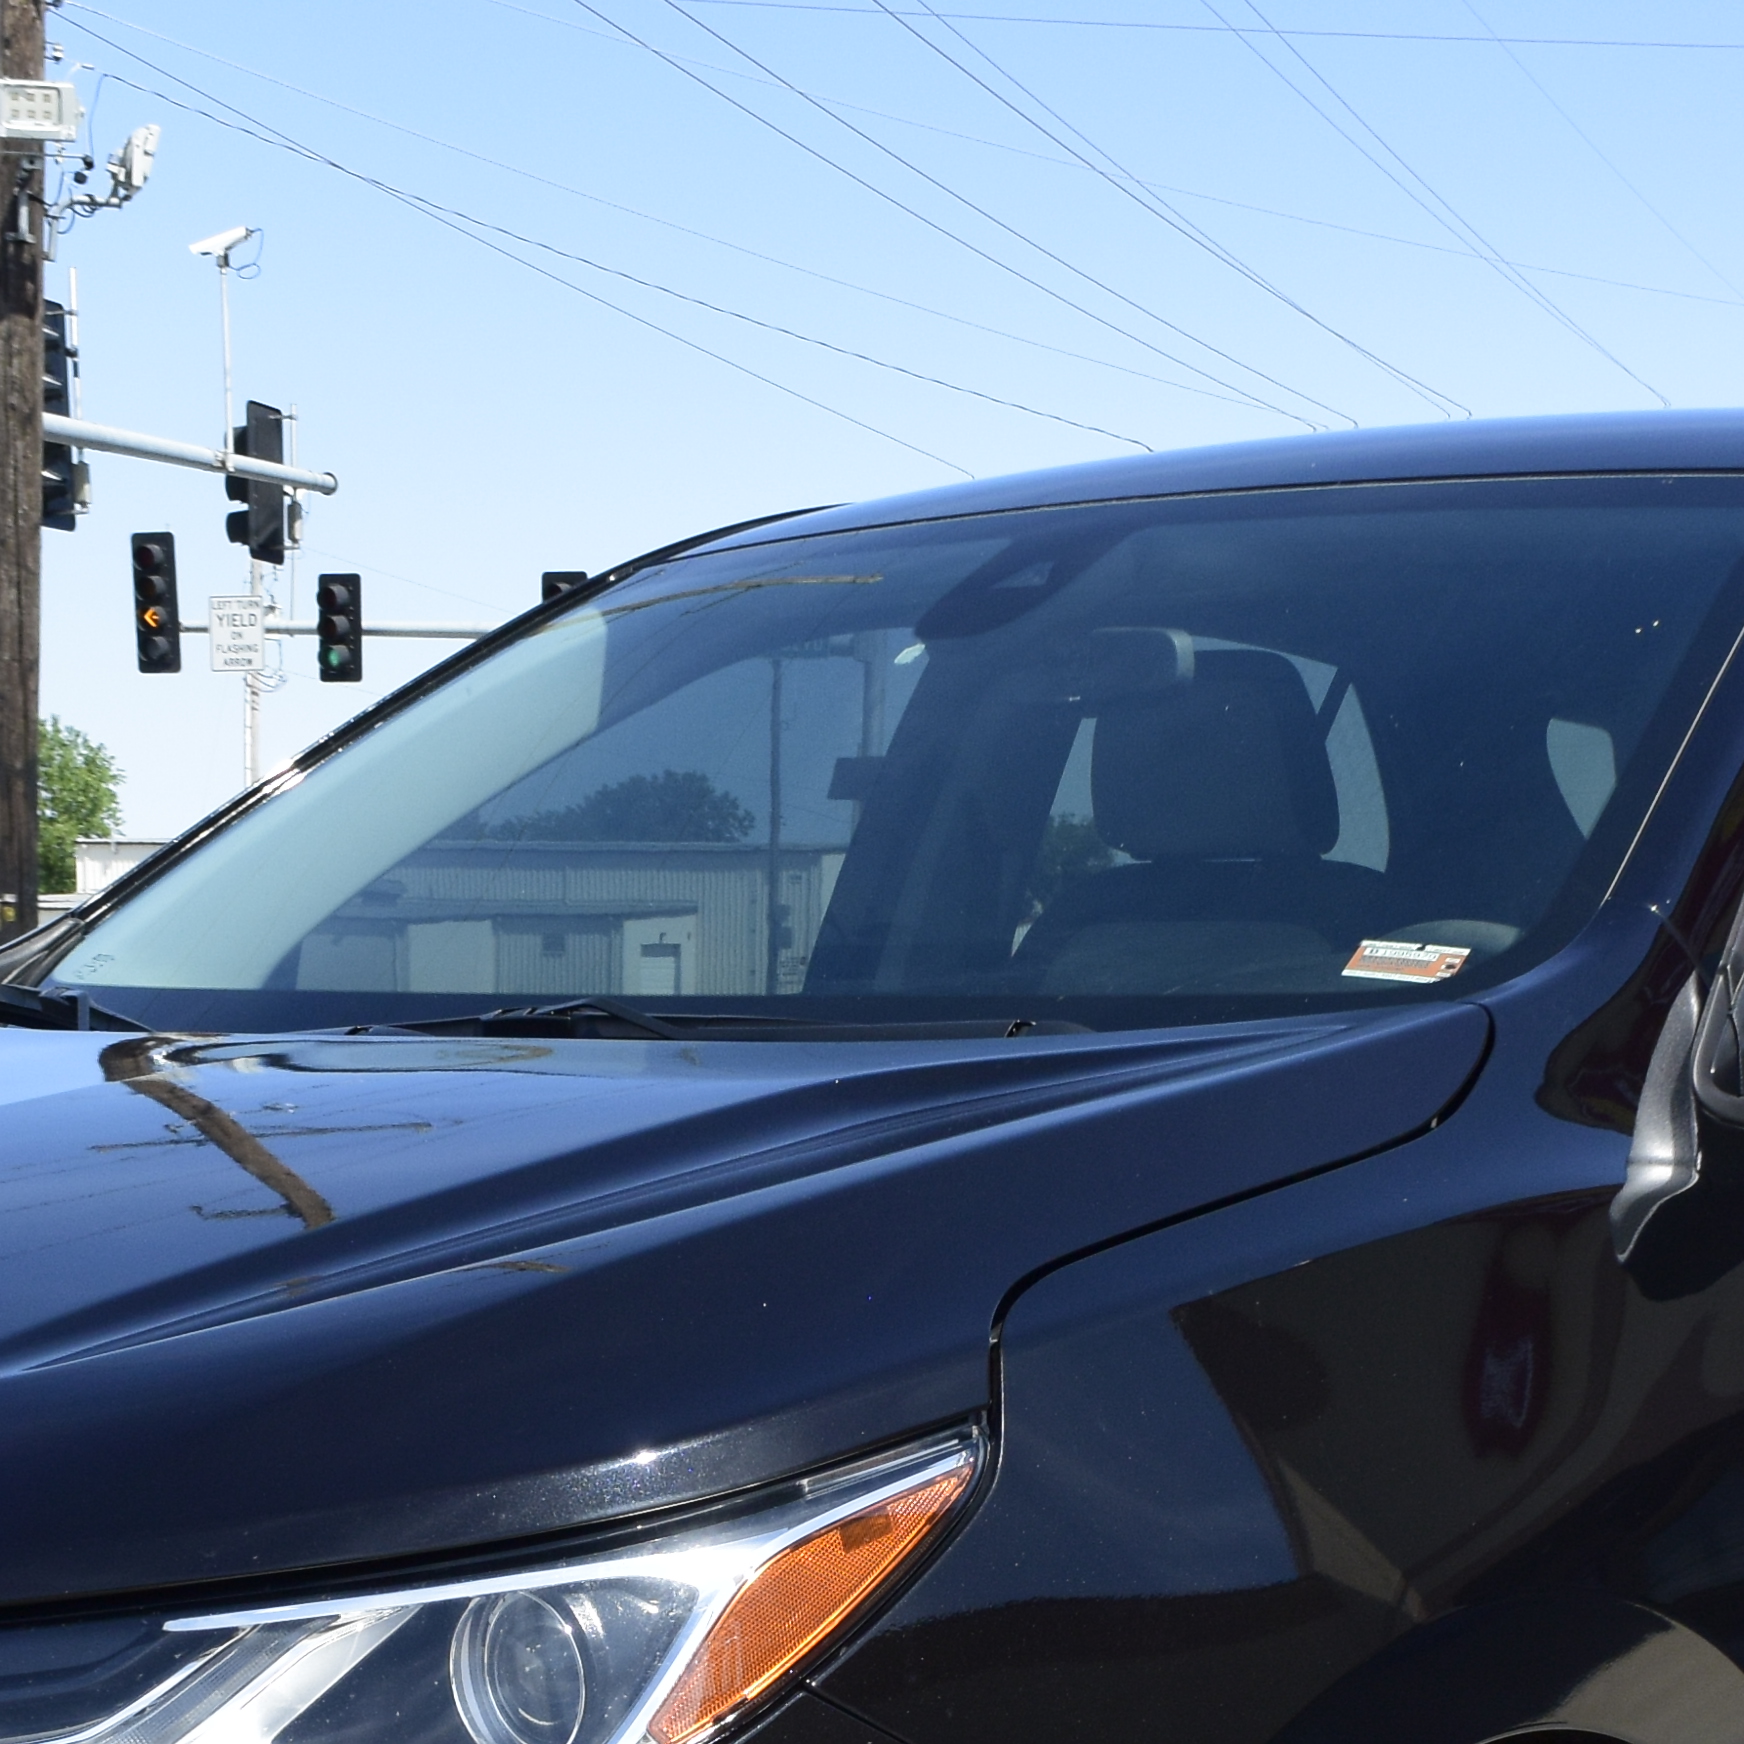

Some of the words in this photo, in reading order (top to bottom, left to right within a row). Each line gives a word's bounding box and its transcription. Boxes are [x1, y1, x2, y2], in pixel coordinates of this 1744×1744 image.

[212, 600, 231, 610] LEFT
[215, 613, 257, 628] YIELD
[230, 631, 243, 641] ON
[215, 644, 258, 655] FLASHING
